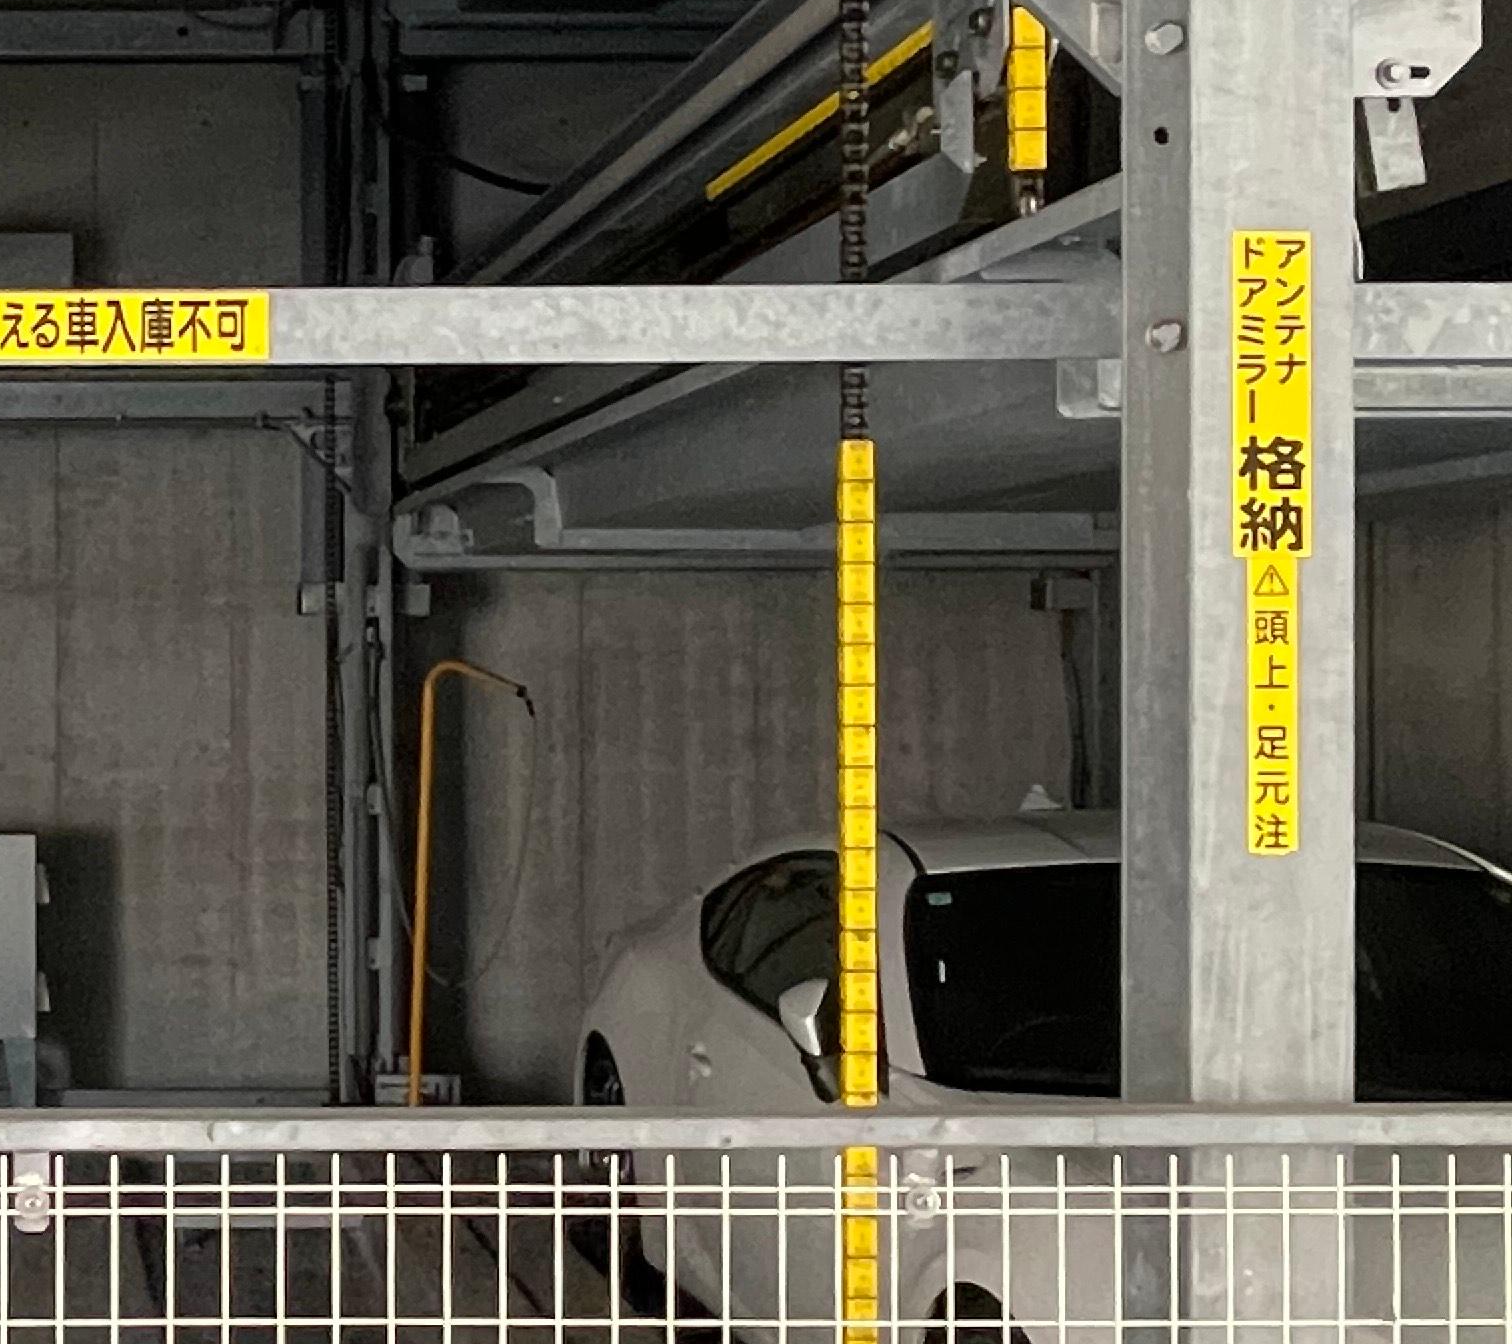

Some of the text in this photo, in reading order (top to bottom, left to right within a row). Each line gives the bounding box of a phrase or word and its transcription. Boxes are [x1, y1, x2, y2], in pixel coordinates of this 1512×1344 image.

[1237, 237, 1267, 423] ドアミラー
[1275, 240, 1306, 384] アンテナ
[1238, 436, 1306, 551] 格納
[1254, 610, 1289, 848] 頭上・足元注
